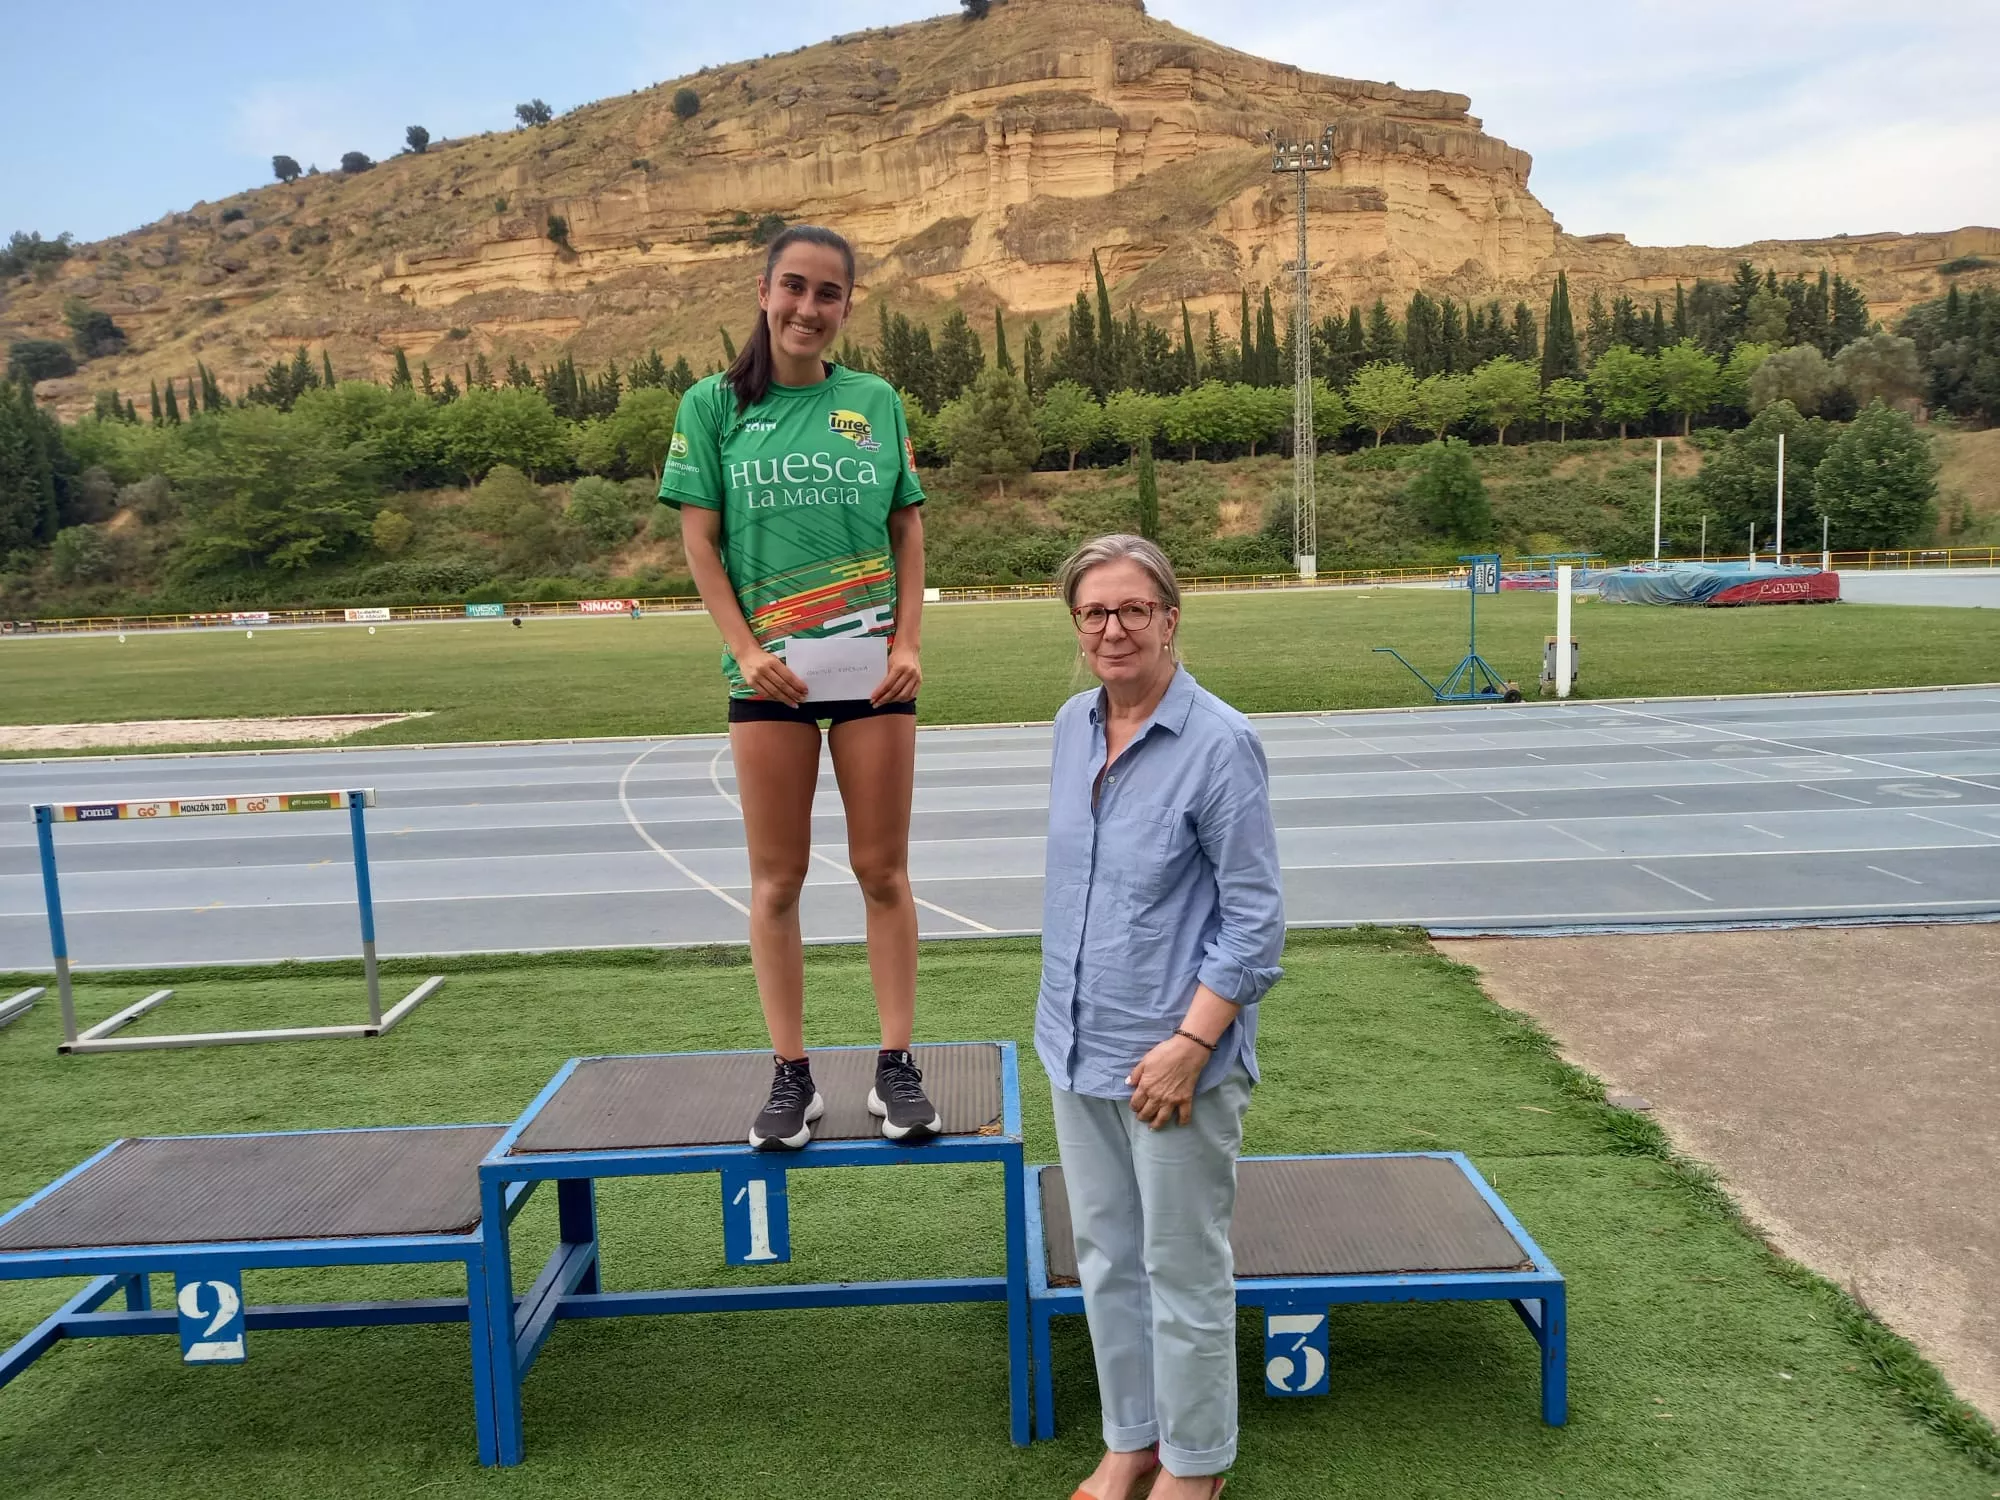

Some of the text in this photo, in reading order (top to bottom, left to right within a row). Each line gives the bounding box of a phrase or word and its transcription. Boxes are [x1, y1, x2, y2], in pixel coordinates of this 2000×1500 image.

[732, 1180, 778, 1260] 1
[178, 1280, 245, 1361] 2
[1266, 1314, 1326, 1392] 3
